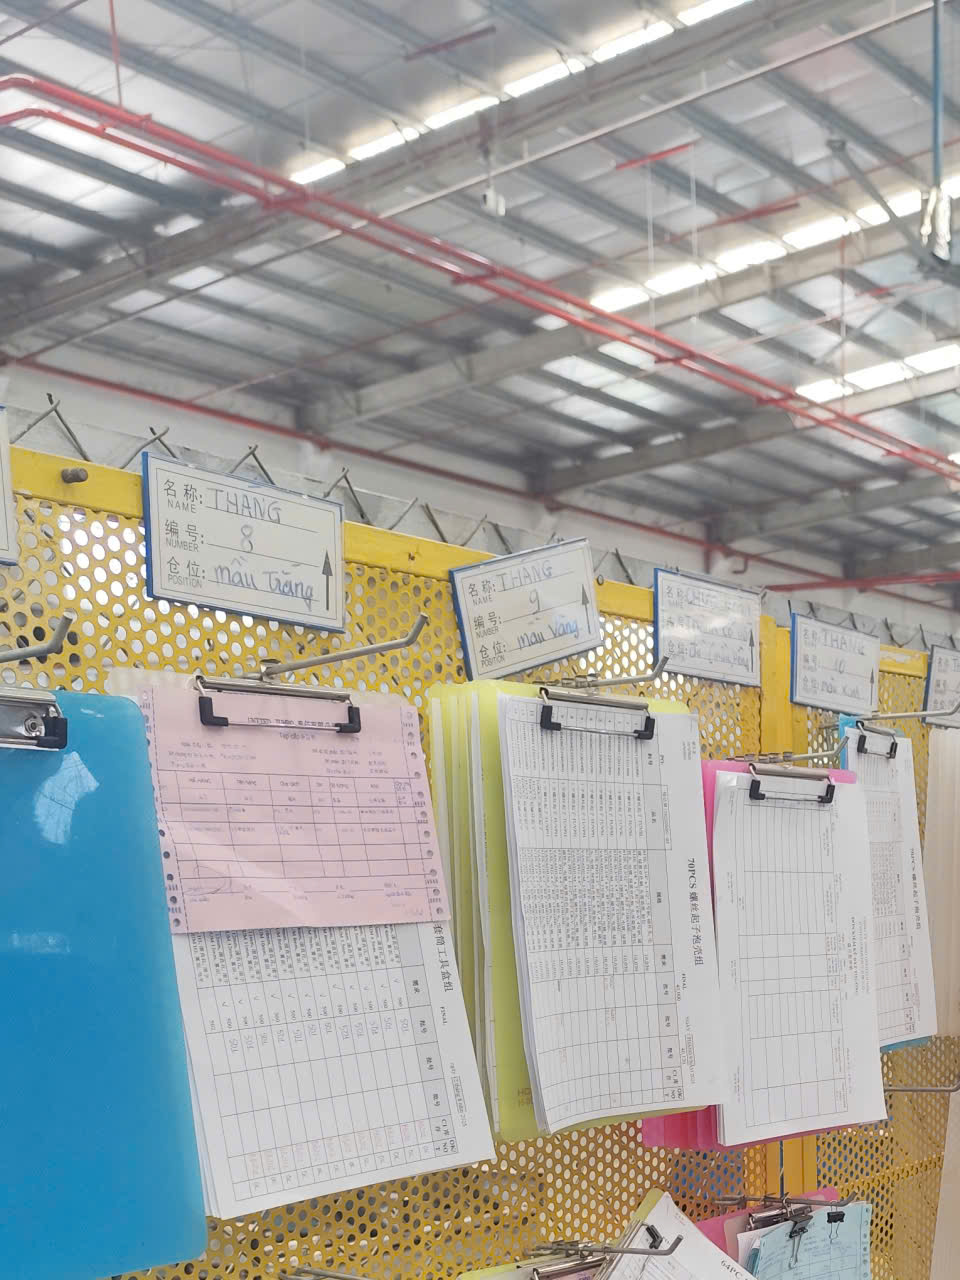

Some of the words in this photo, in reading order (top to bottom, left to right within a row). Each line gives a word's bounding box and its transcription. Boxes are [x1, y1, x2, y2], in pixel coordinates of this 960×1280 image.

[167, 500, 197, 513] NAME
[166, 537, 199, 552] NUMBER
[240, 524, 254, 552] 8
[168, 573, 202, 588] POSITION
[496, 560, 553, 592] THANG
[472, 595, 493, 606] NAME
[475, 626, 499, 638] NUMBER
[481, 654, 505, 668] POSITION
[688, 858, 697, 889] 70PCS
[721, 1259, 742, 1279] 64PC
